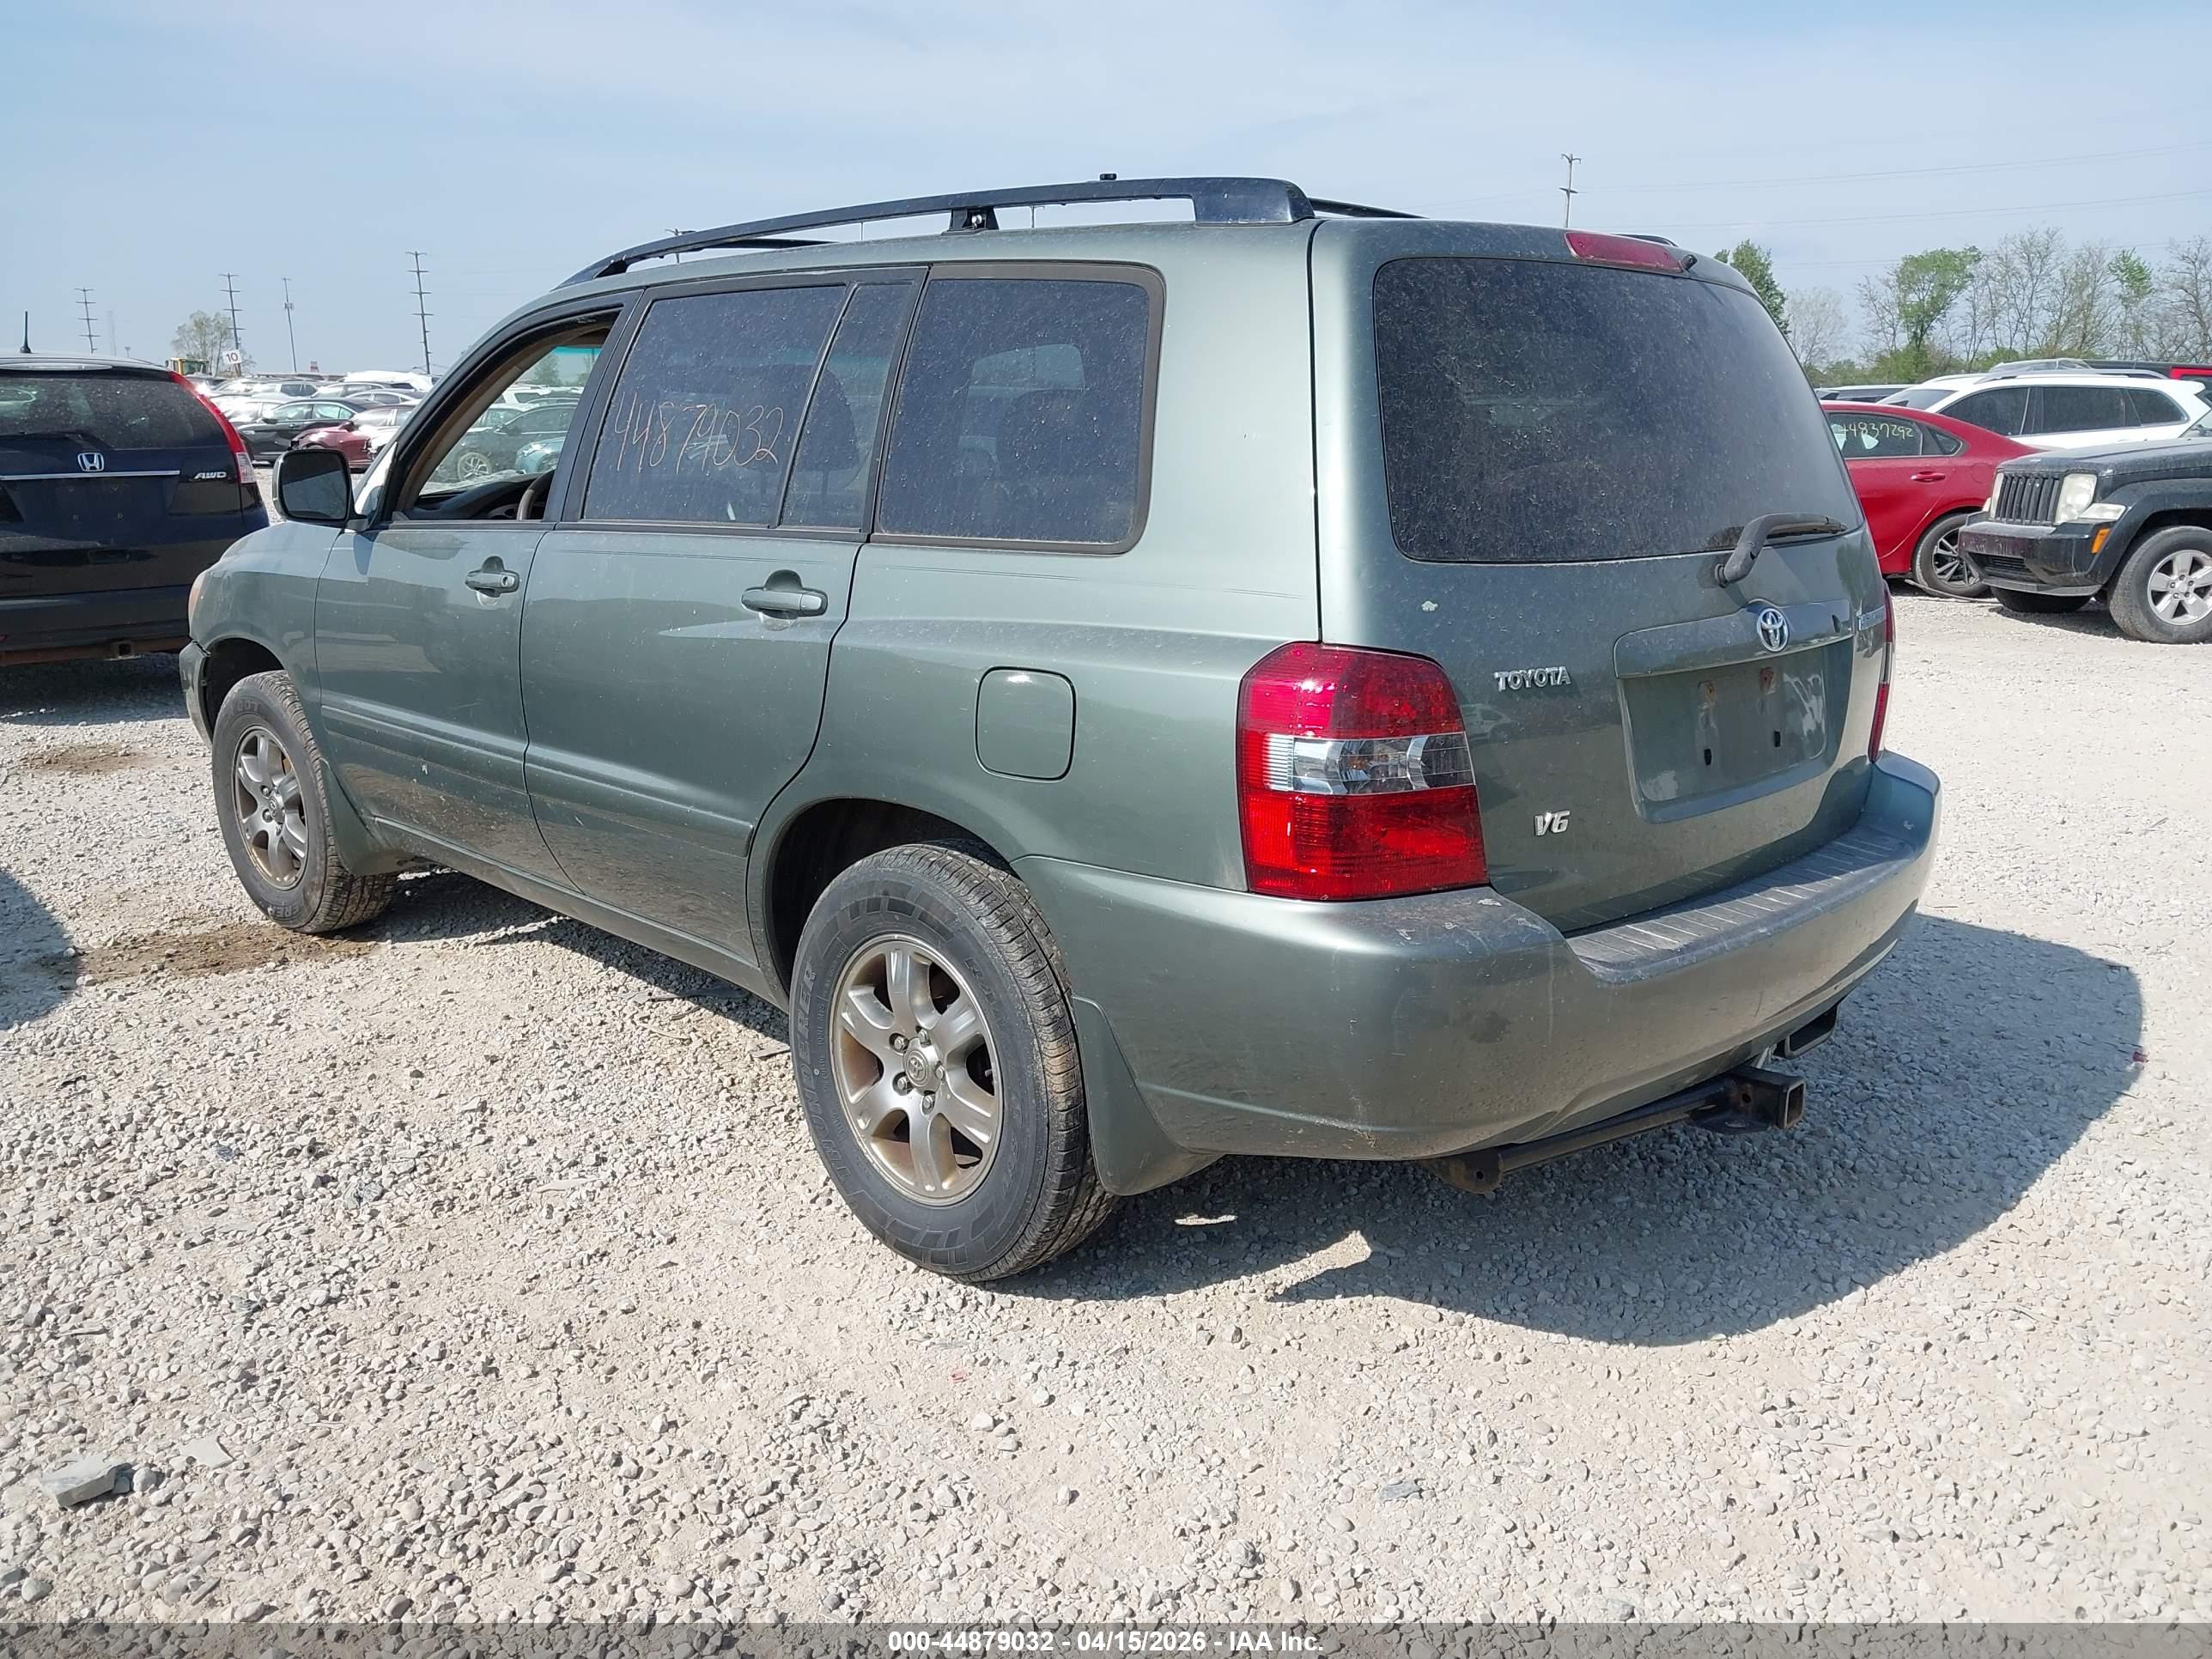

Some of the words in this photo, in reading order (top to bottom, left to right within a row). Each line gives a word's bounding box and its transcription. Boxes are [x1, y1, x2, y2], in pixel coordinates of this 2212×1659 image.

[225, 352, 239, 362] 10
[614, 392, 784, 474] 44879032
[192, 470, 228, 482] AWD
[1493, 665, 1571, 693] TOYOTA
[1533, 810, 1571, 837] V6
